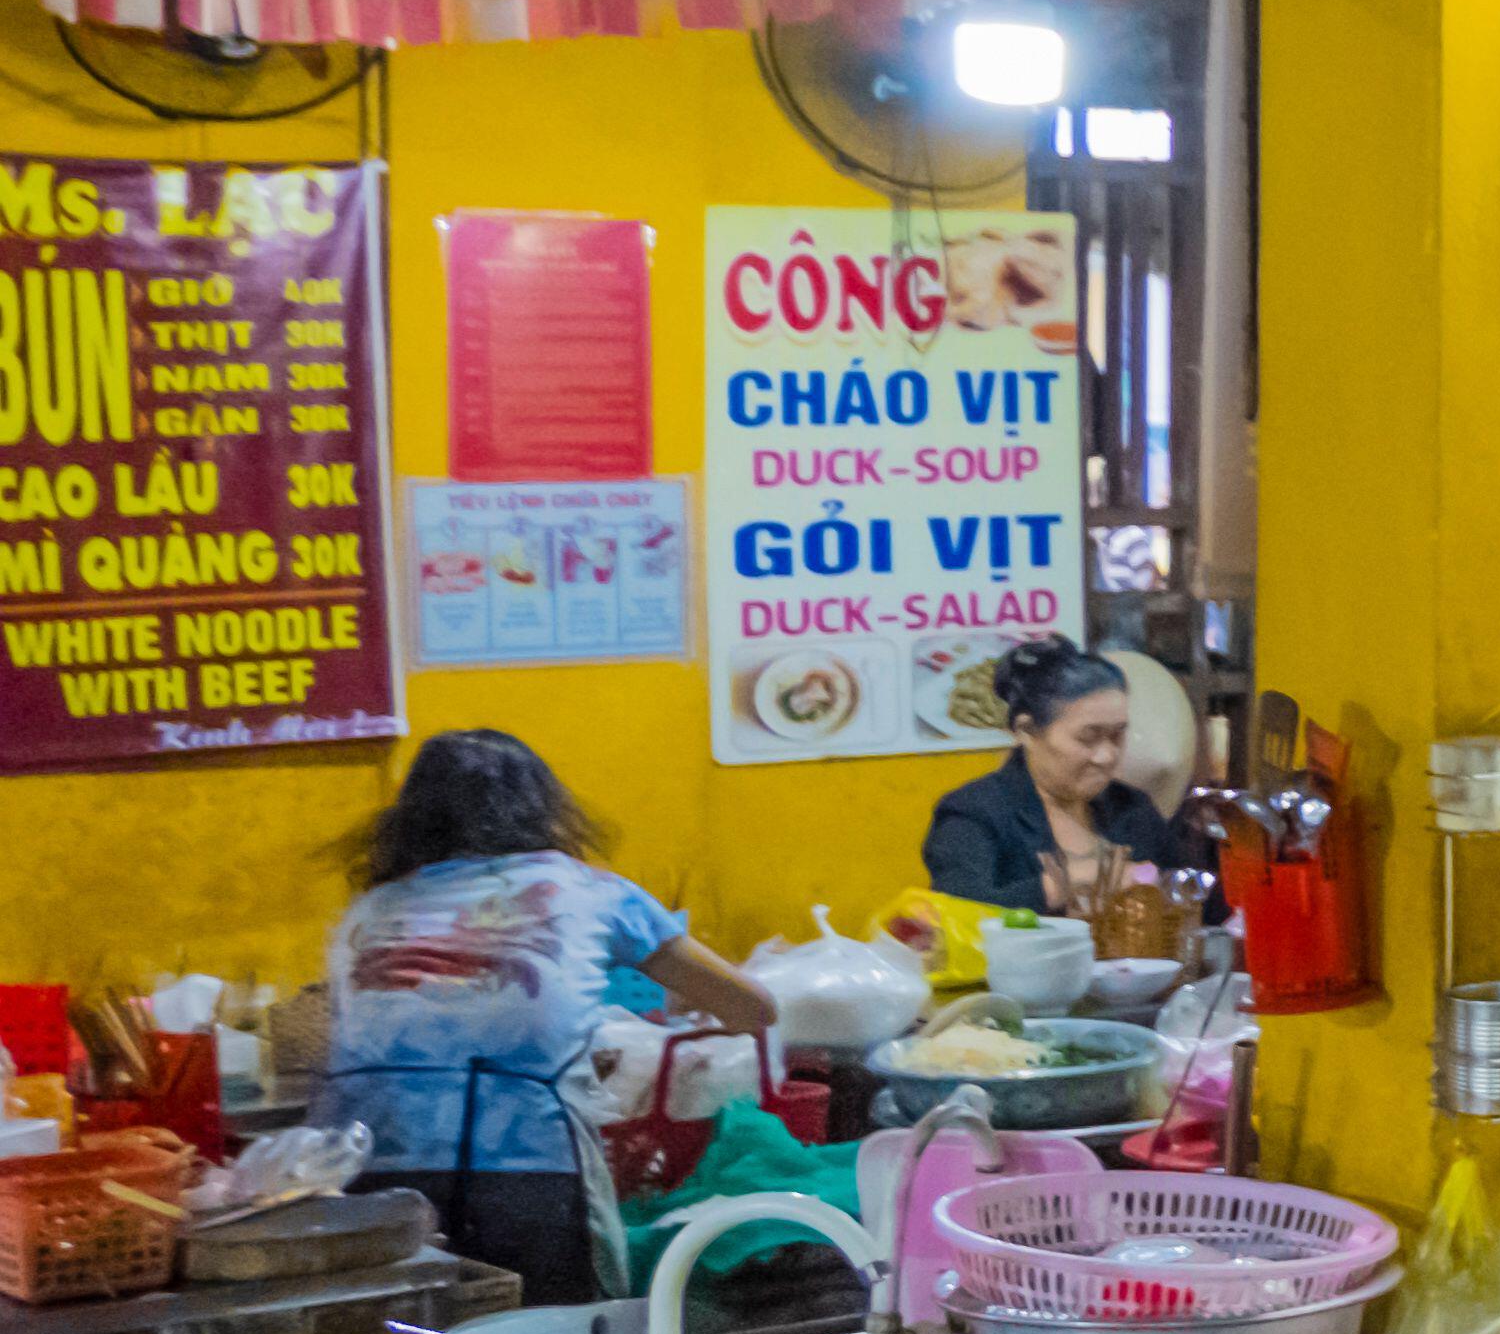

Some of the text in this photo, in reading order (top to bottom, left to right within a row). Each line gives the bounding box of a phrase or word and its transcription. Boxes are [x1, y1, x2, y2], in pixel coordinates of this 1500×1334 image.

[0, 162, 337, 258] Ms. LẠC
[723, 228, 947, 333] CÔNG
[727, 357, 1060, 437] CHÁO VỊT
[287, 463, 359, 509] 30K
[0, 527, 62, 594] MÌ
[290, 531, 363, 579] 30K
[734, 499, 1063, 582] GỎI VỊT
[3, 605, 361, 668] WHITE NOODLE
[59, 657, 316, 719] WITH BEEF
